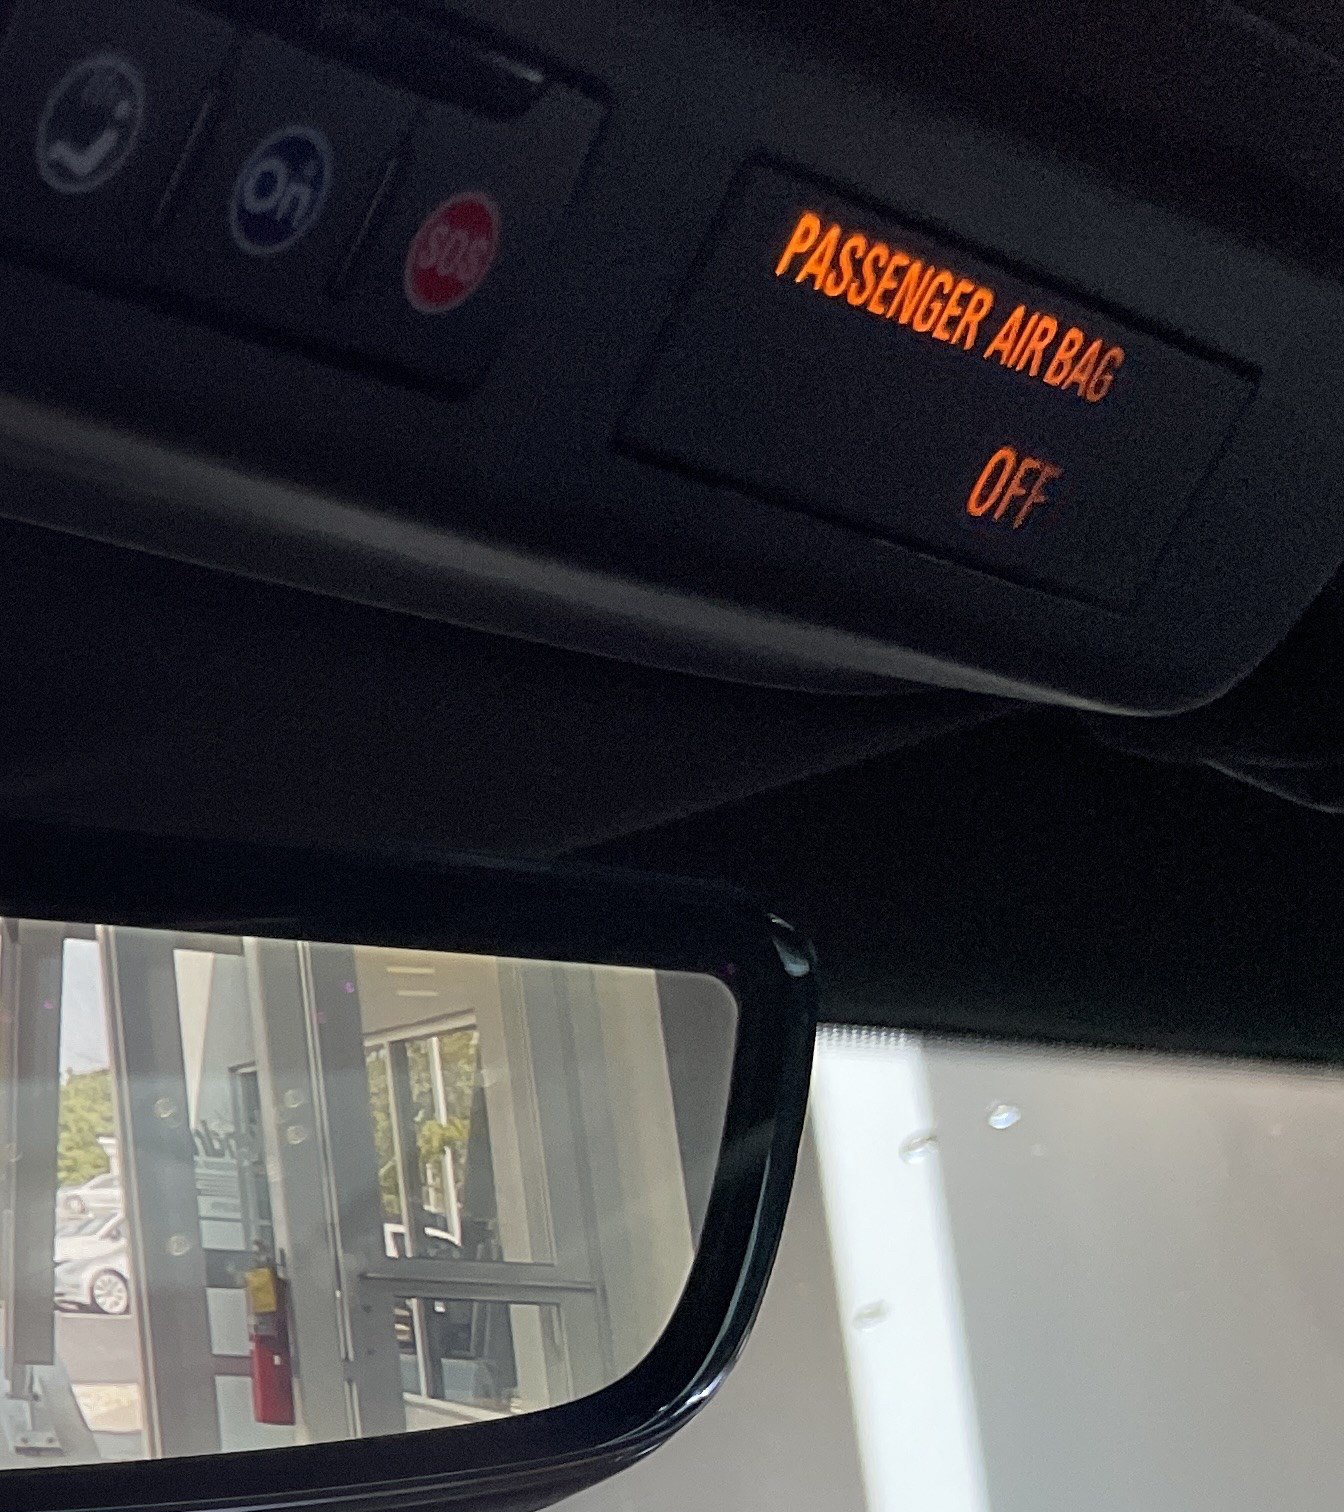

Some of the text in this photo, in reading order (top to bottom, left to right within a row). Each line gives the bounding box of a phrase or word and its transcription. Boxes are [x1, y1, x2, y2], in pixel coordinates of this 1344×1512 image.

[417, 224, 490, 283] SOS
[774, 208, 997, 352] PASSENGER
[965, 446, 1064, 530] OFF
